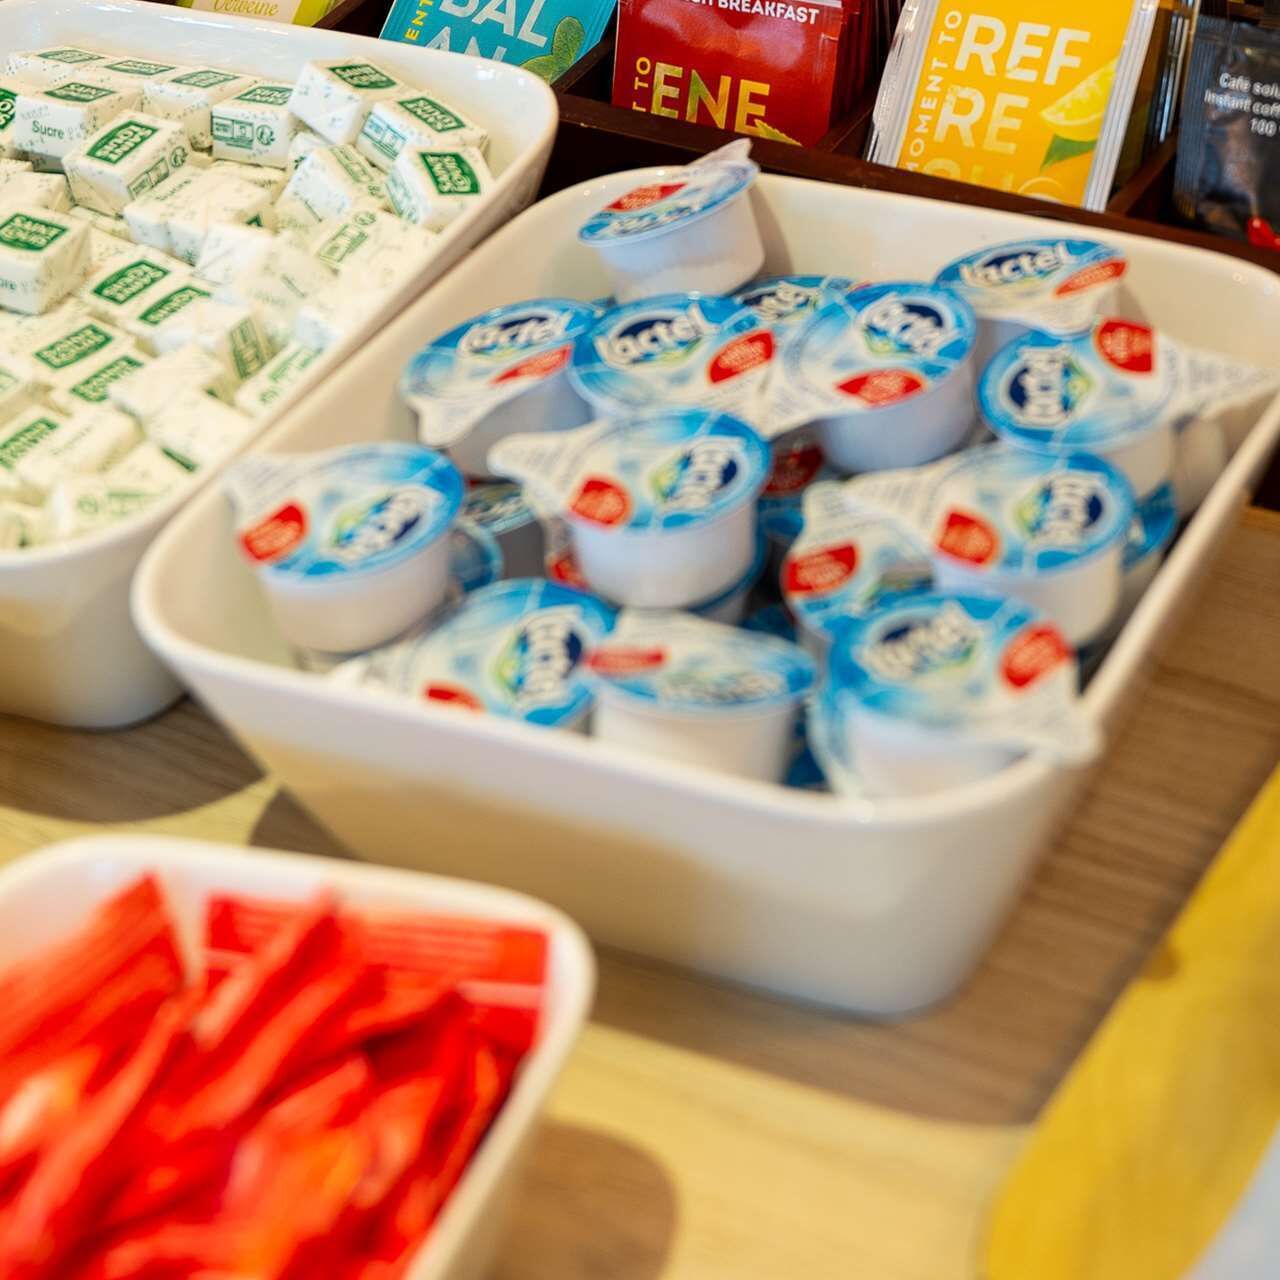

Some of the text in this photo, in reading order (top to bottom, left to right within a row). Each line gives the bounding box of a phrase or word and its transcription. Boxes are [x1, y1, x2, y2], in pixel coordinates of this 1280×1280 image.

[937, 9, 962, 45] TO
[953, 13, 1092, 86] REF
[633, 55, 651, 90] TO
[650, 61, 771, 139] ENE
[32, 120, 66, 139] Sucre
[933, 84, 1031, 156] RE
[108, 128, 152, 163] SAINT
